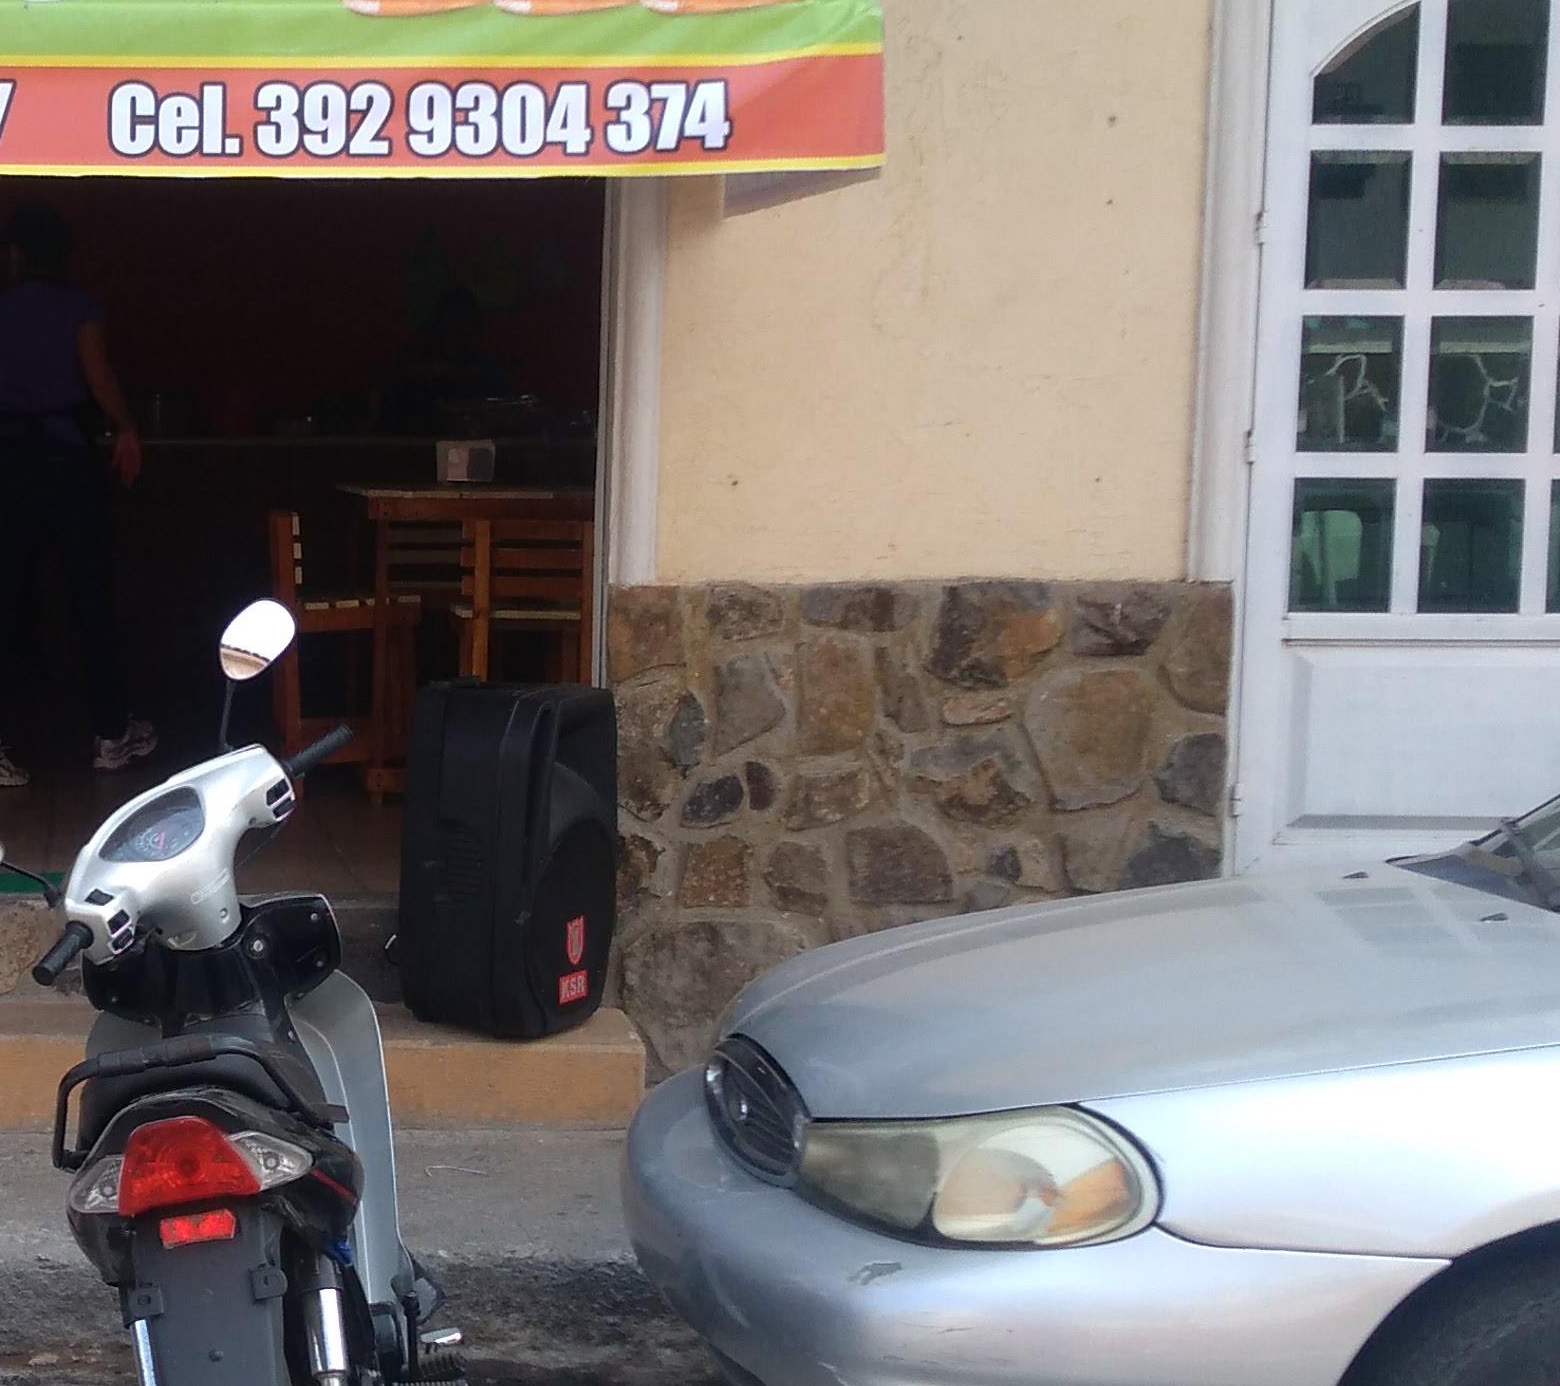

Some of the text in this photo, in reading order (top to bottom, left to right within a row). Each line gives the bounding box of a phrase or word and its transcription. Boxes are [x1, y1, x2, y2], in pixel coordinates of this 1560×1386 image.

[109, 81, 241, 157] Cel.
[256, 80, 393, 156] 392
[407, 80, 592, 156] 9304
[605, 79, 731, 152] 374
[561, 974, 586, 999] KSR
